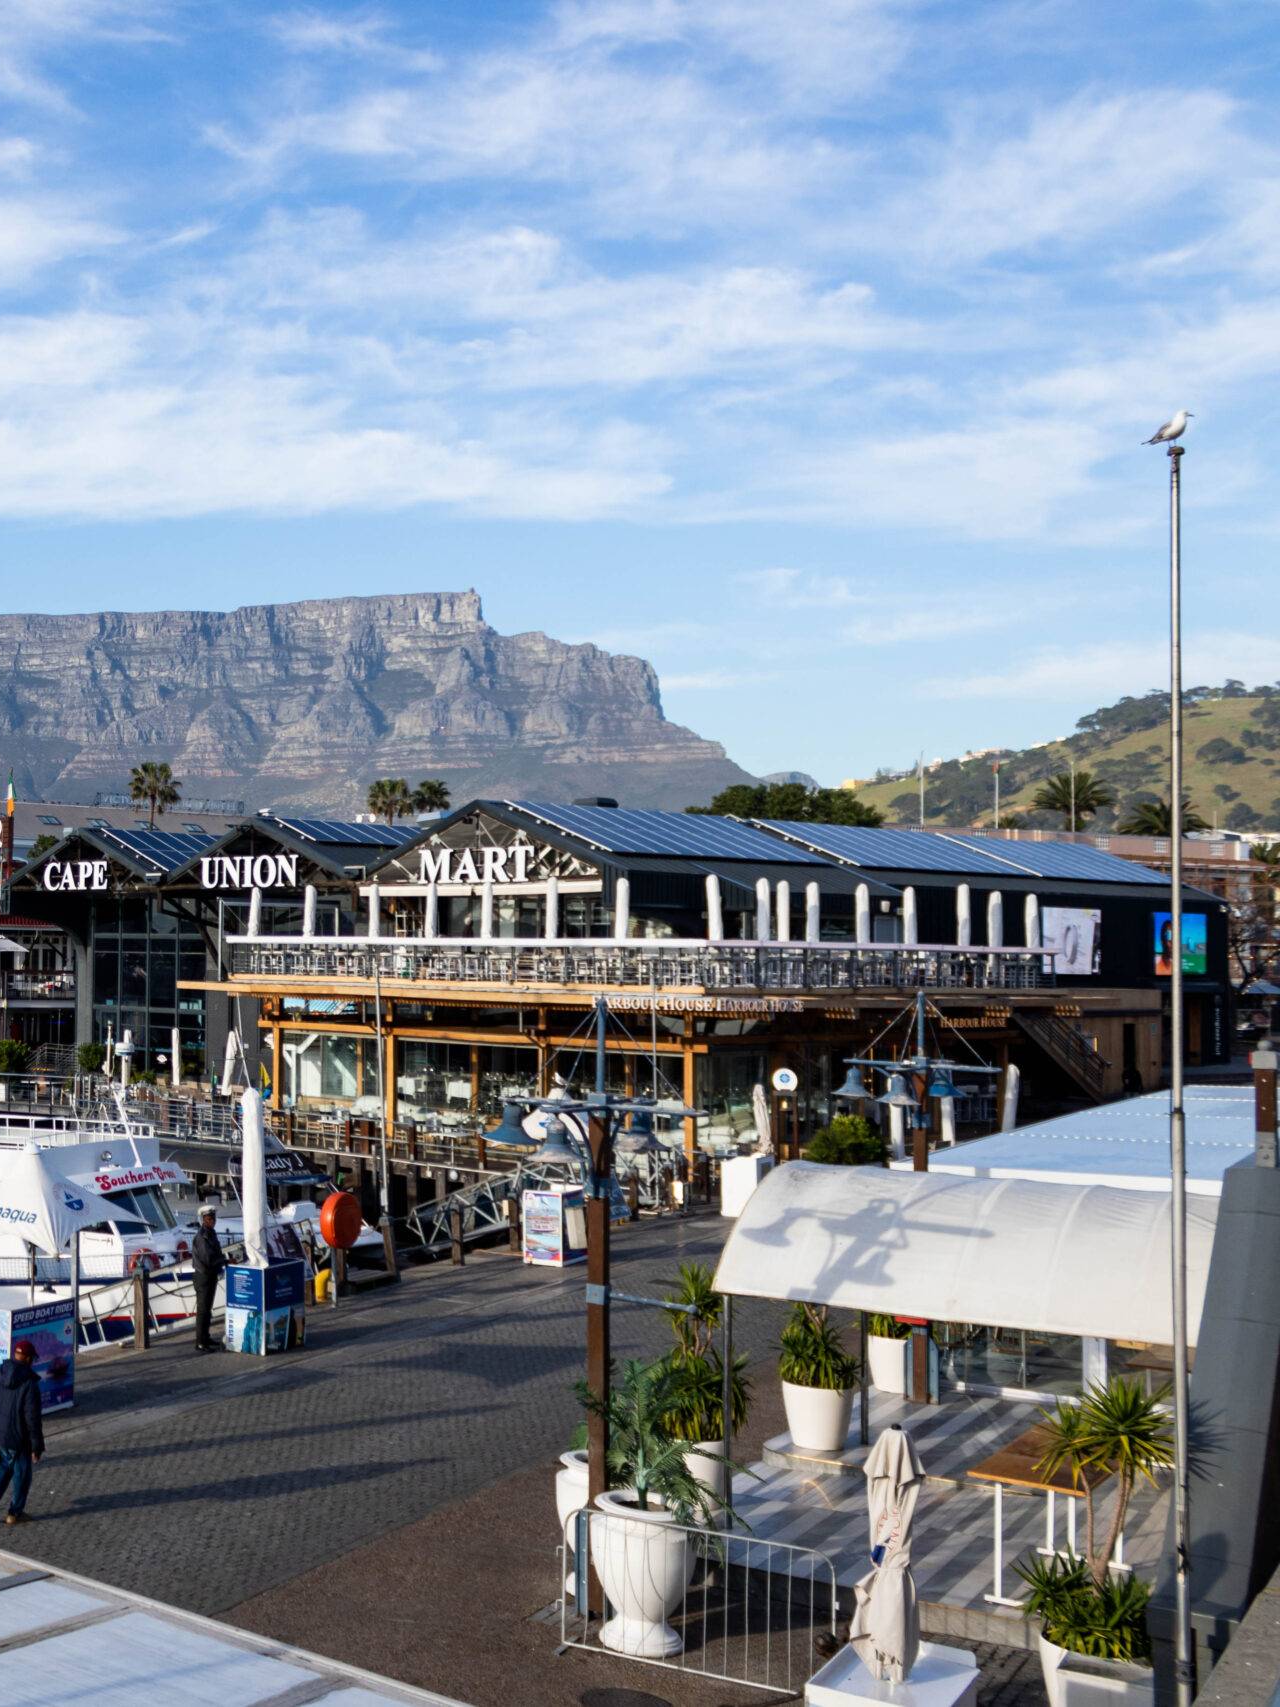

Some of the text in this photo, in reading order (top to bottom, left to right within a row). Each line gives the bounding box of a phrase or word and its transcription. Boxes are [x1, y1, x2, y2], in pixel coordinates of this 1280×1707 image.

[43, 845, 534, 891] CAPE UNION MART
[663, 997, 713, 1011] HOUSE
[716, 998, 769, 1012] HARBOUR
[941, 1016, 1007, 1028] HARBOUR HOUSE
[95, 1170, 155, 1191] Southern
[13, 1310, 35, 1325] SPEED
[35, 1306, 54, 1320] BOAT
[55, 1301, 74, 1315] RIDES
